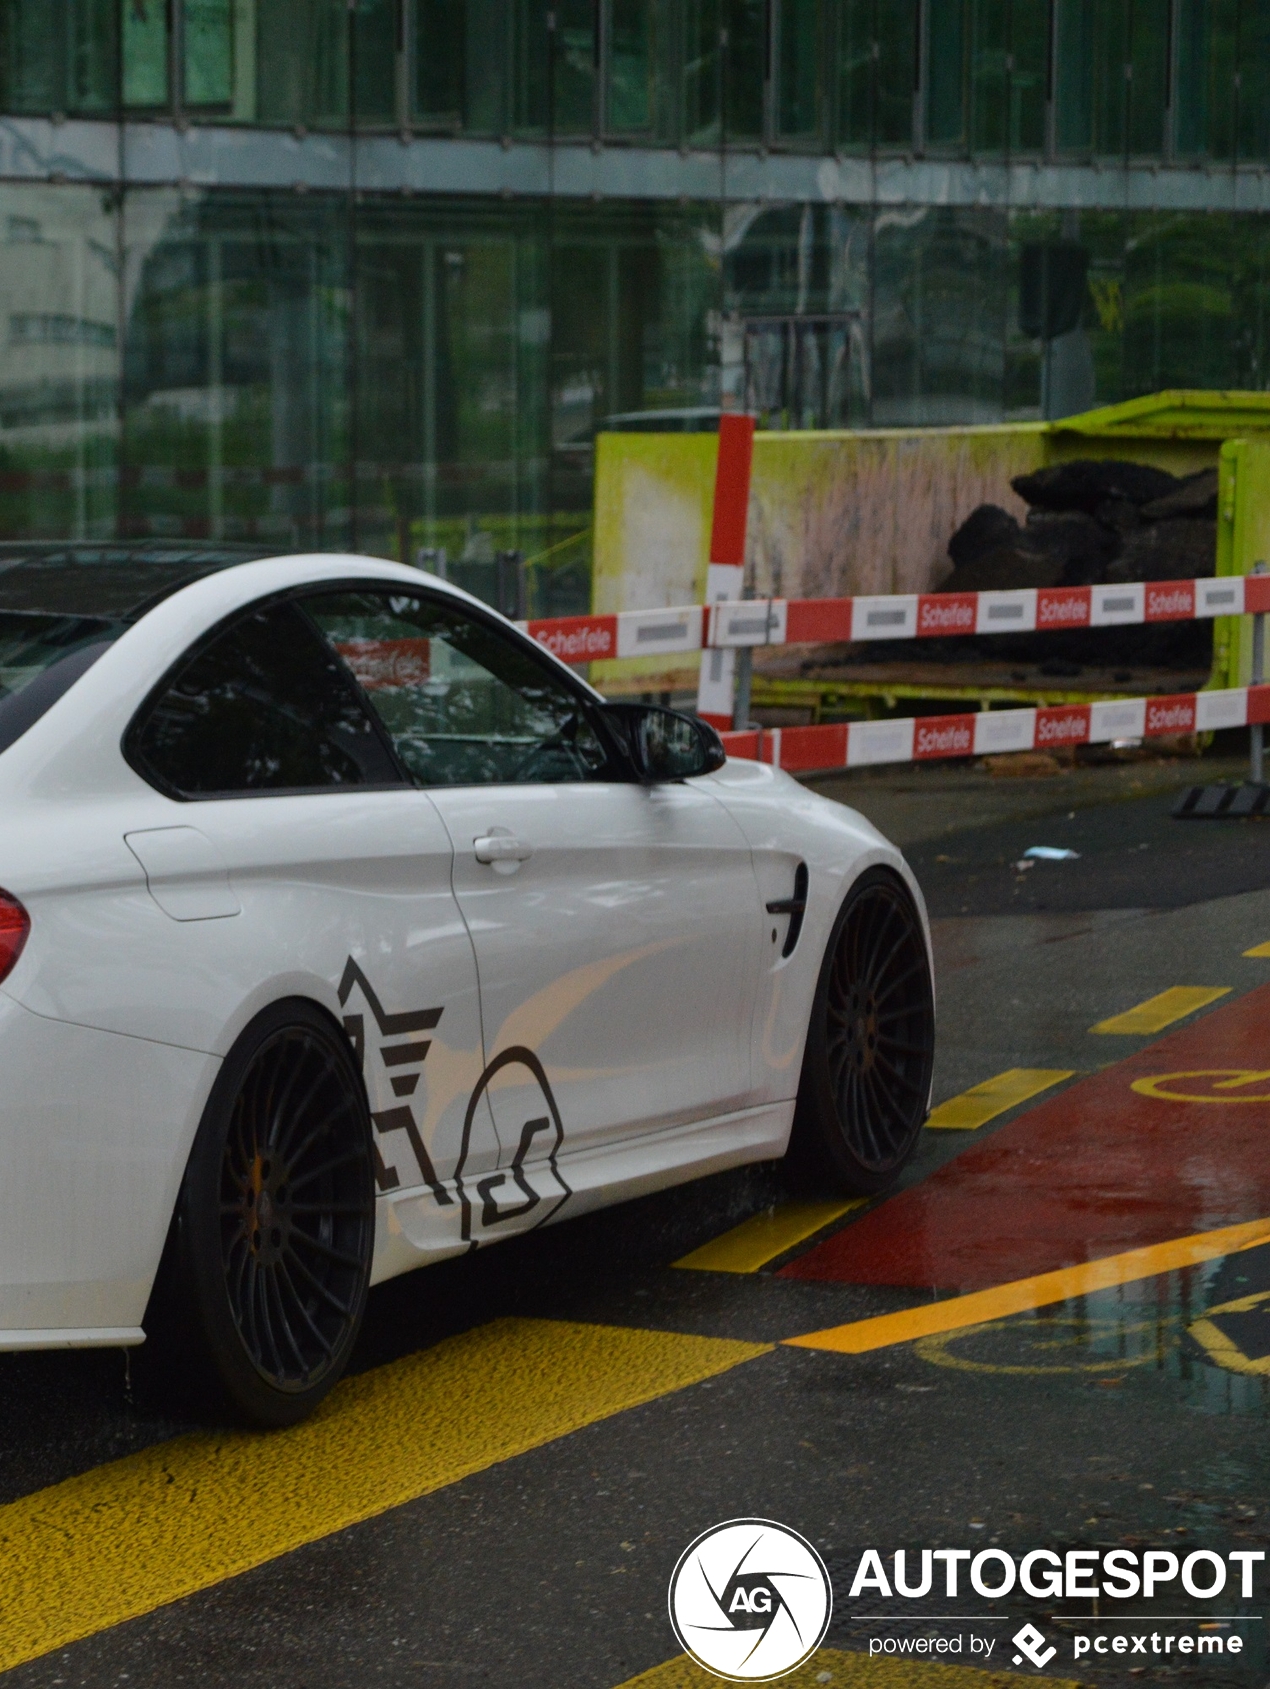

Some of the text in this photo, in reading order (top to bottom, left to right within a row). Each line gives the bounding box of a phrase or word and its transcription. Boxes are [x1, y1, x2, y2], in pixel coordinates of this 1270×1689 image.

[921, 602, 973, 628] Scheifele
[1039, 597, 1088, 622] Scheifele
[1149, 591, 1192, 615] Scheifele
[535, 626, 611, 656] Scheifele
[1038, 715, 1087, 741] Scheifele
[1148, 706, 1193, 731] Scheifele
[918, 725, 971, 753] Scheifele
